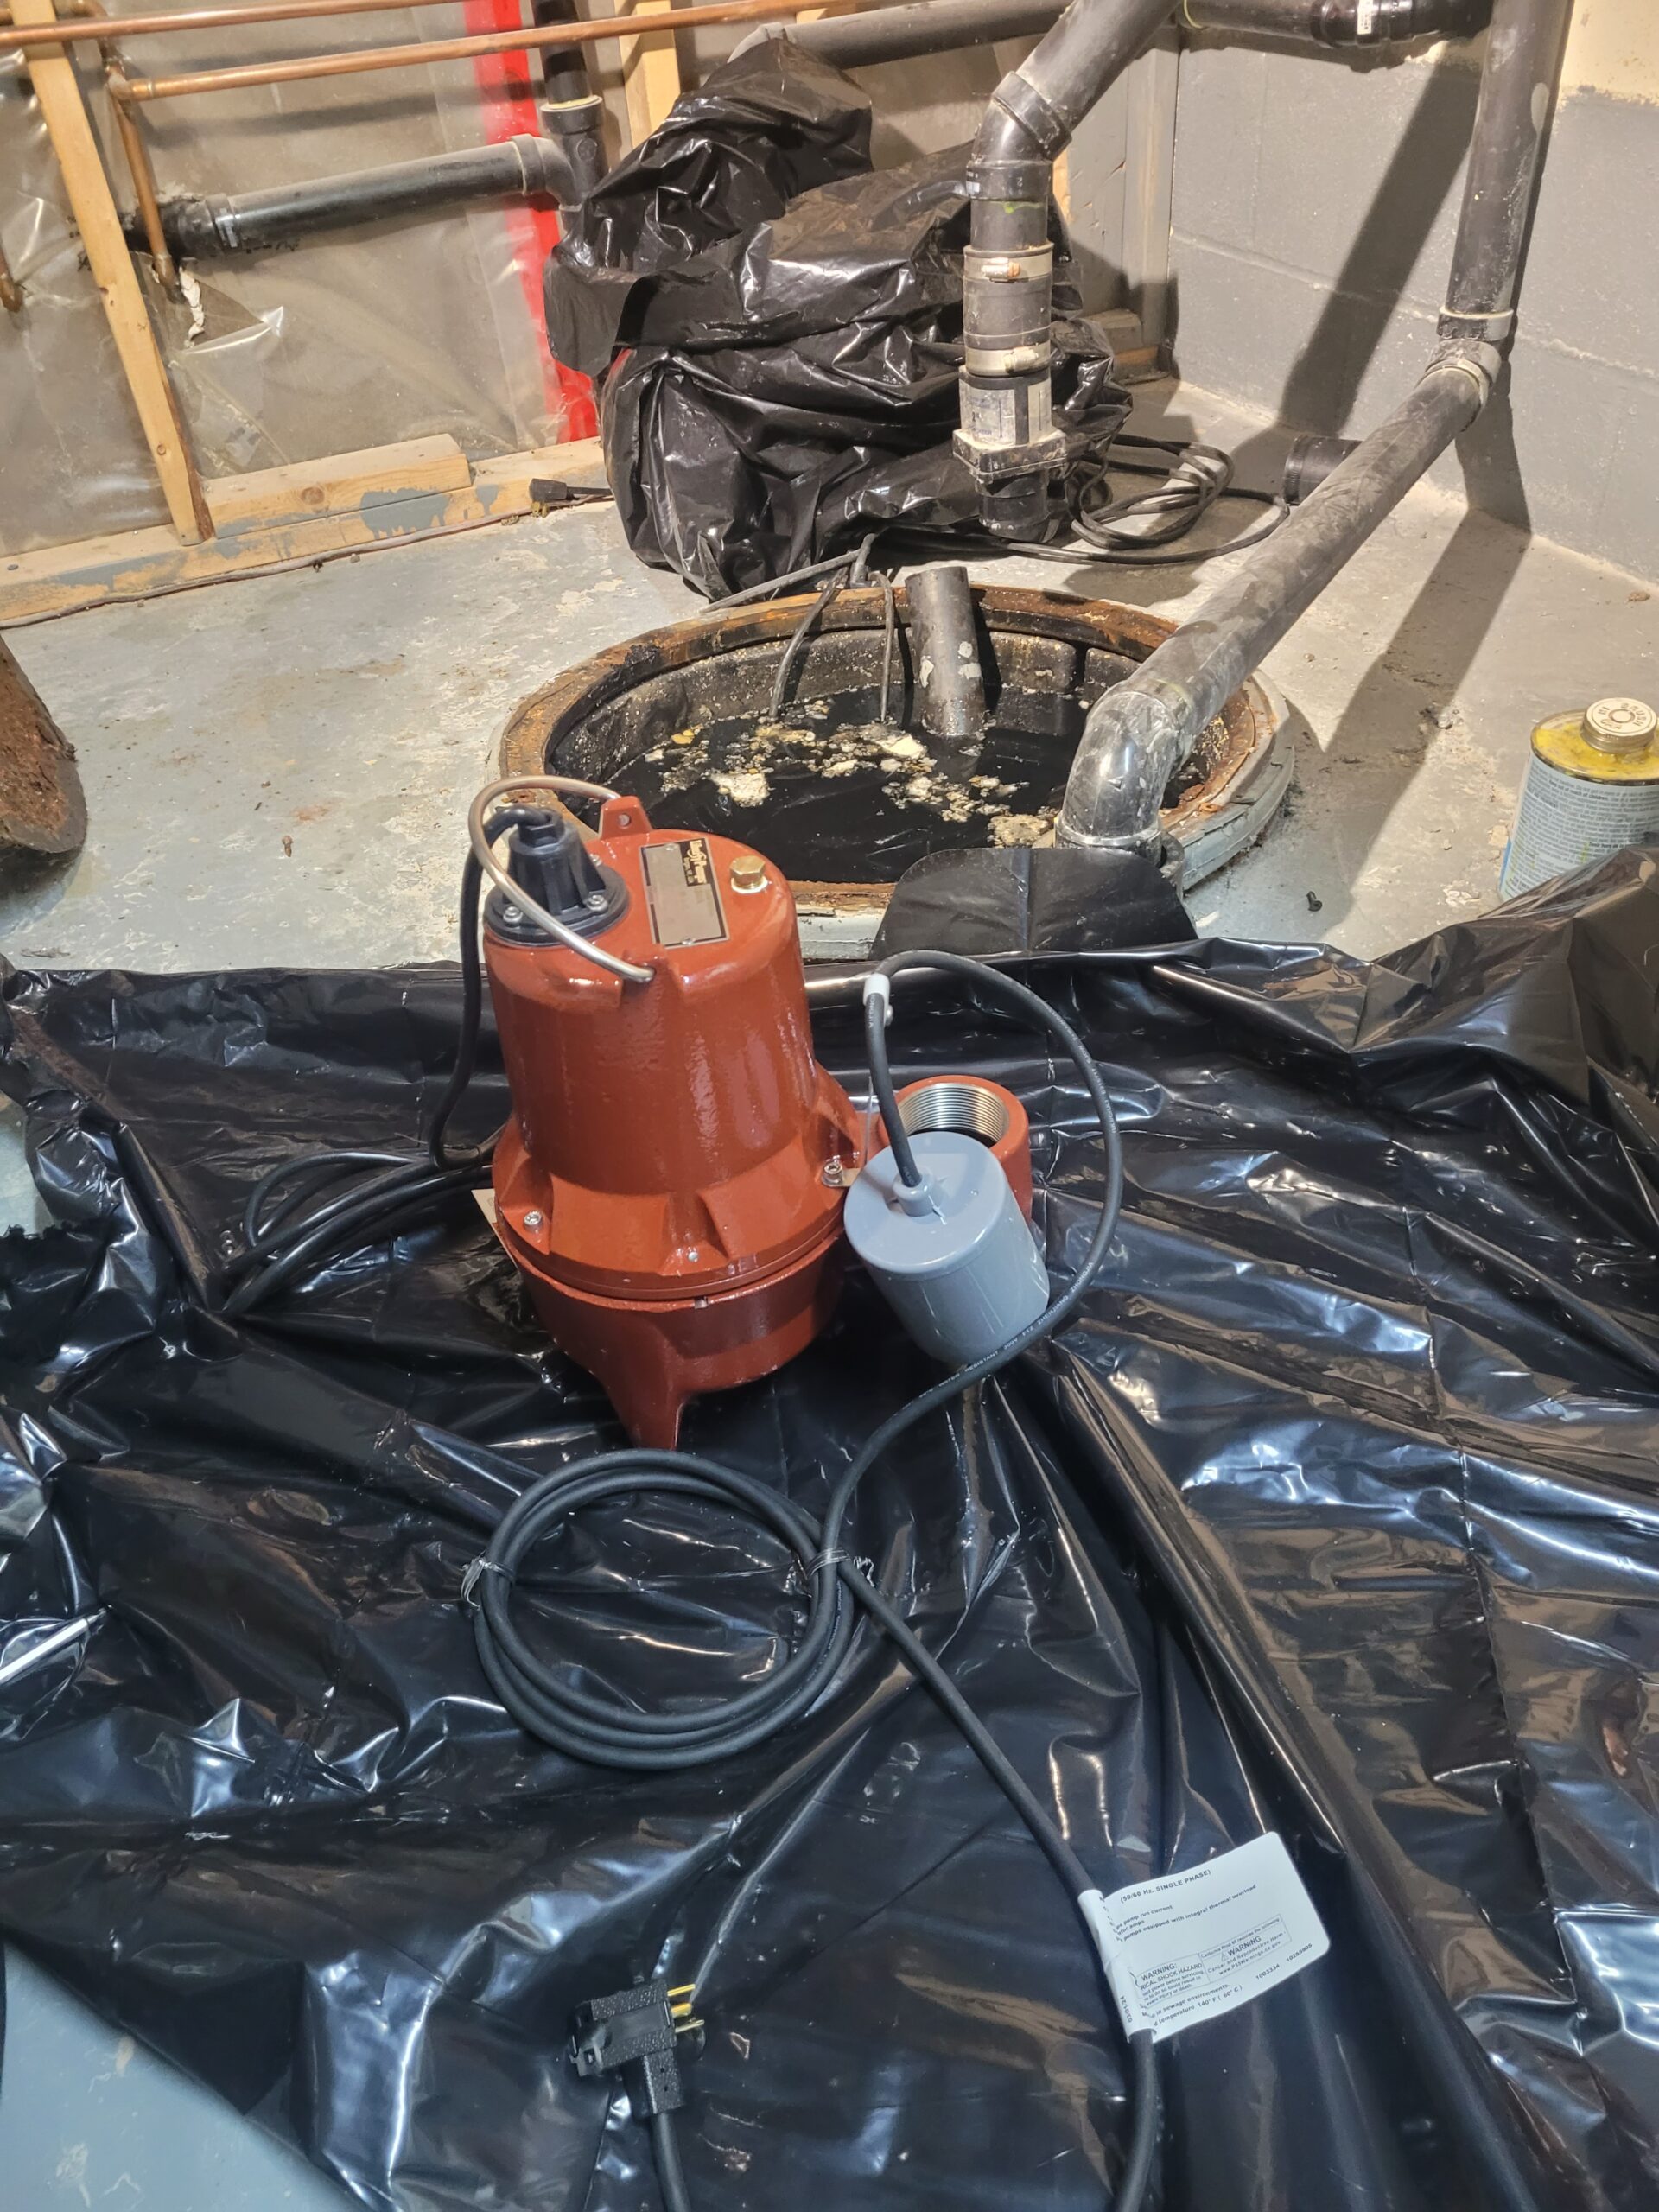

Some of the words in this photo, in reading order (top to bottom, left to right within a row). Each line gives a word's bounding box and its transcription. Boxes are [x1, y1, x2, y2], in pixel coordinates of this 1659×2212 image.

[1156, 1880, 1183, 1891] SINGLE
[1185, 1869, 1211, 1884] PHASE)
[1123, 1929, 1142, 1942] pumps
[1142, 1920, 1170, 1932] equipped
[1185, 1907, 1208, 1919] integral
[1209, 1897, 1231, 1910] thermal
[1231, 1884, 1256, 1899] overload
[1123, 1915, 1139, 1925] pump
[1151, 1905, 1173, 1915] current
[1129, 1920, 1145, 1929] amps
[1228, 1936, 1262, 1956] WARNING
[1141, 1963, 1178, 1981] WARNING:
[1158, 1971, 1178, 1983] SHOCK
[1179, 1963, 1203, 1974] HAZARD
[1159, 2005, 1195, 2024] temperature
[1162, 1999, 1186, 2012] sewage
